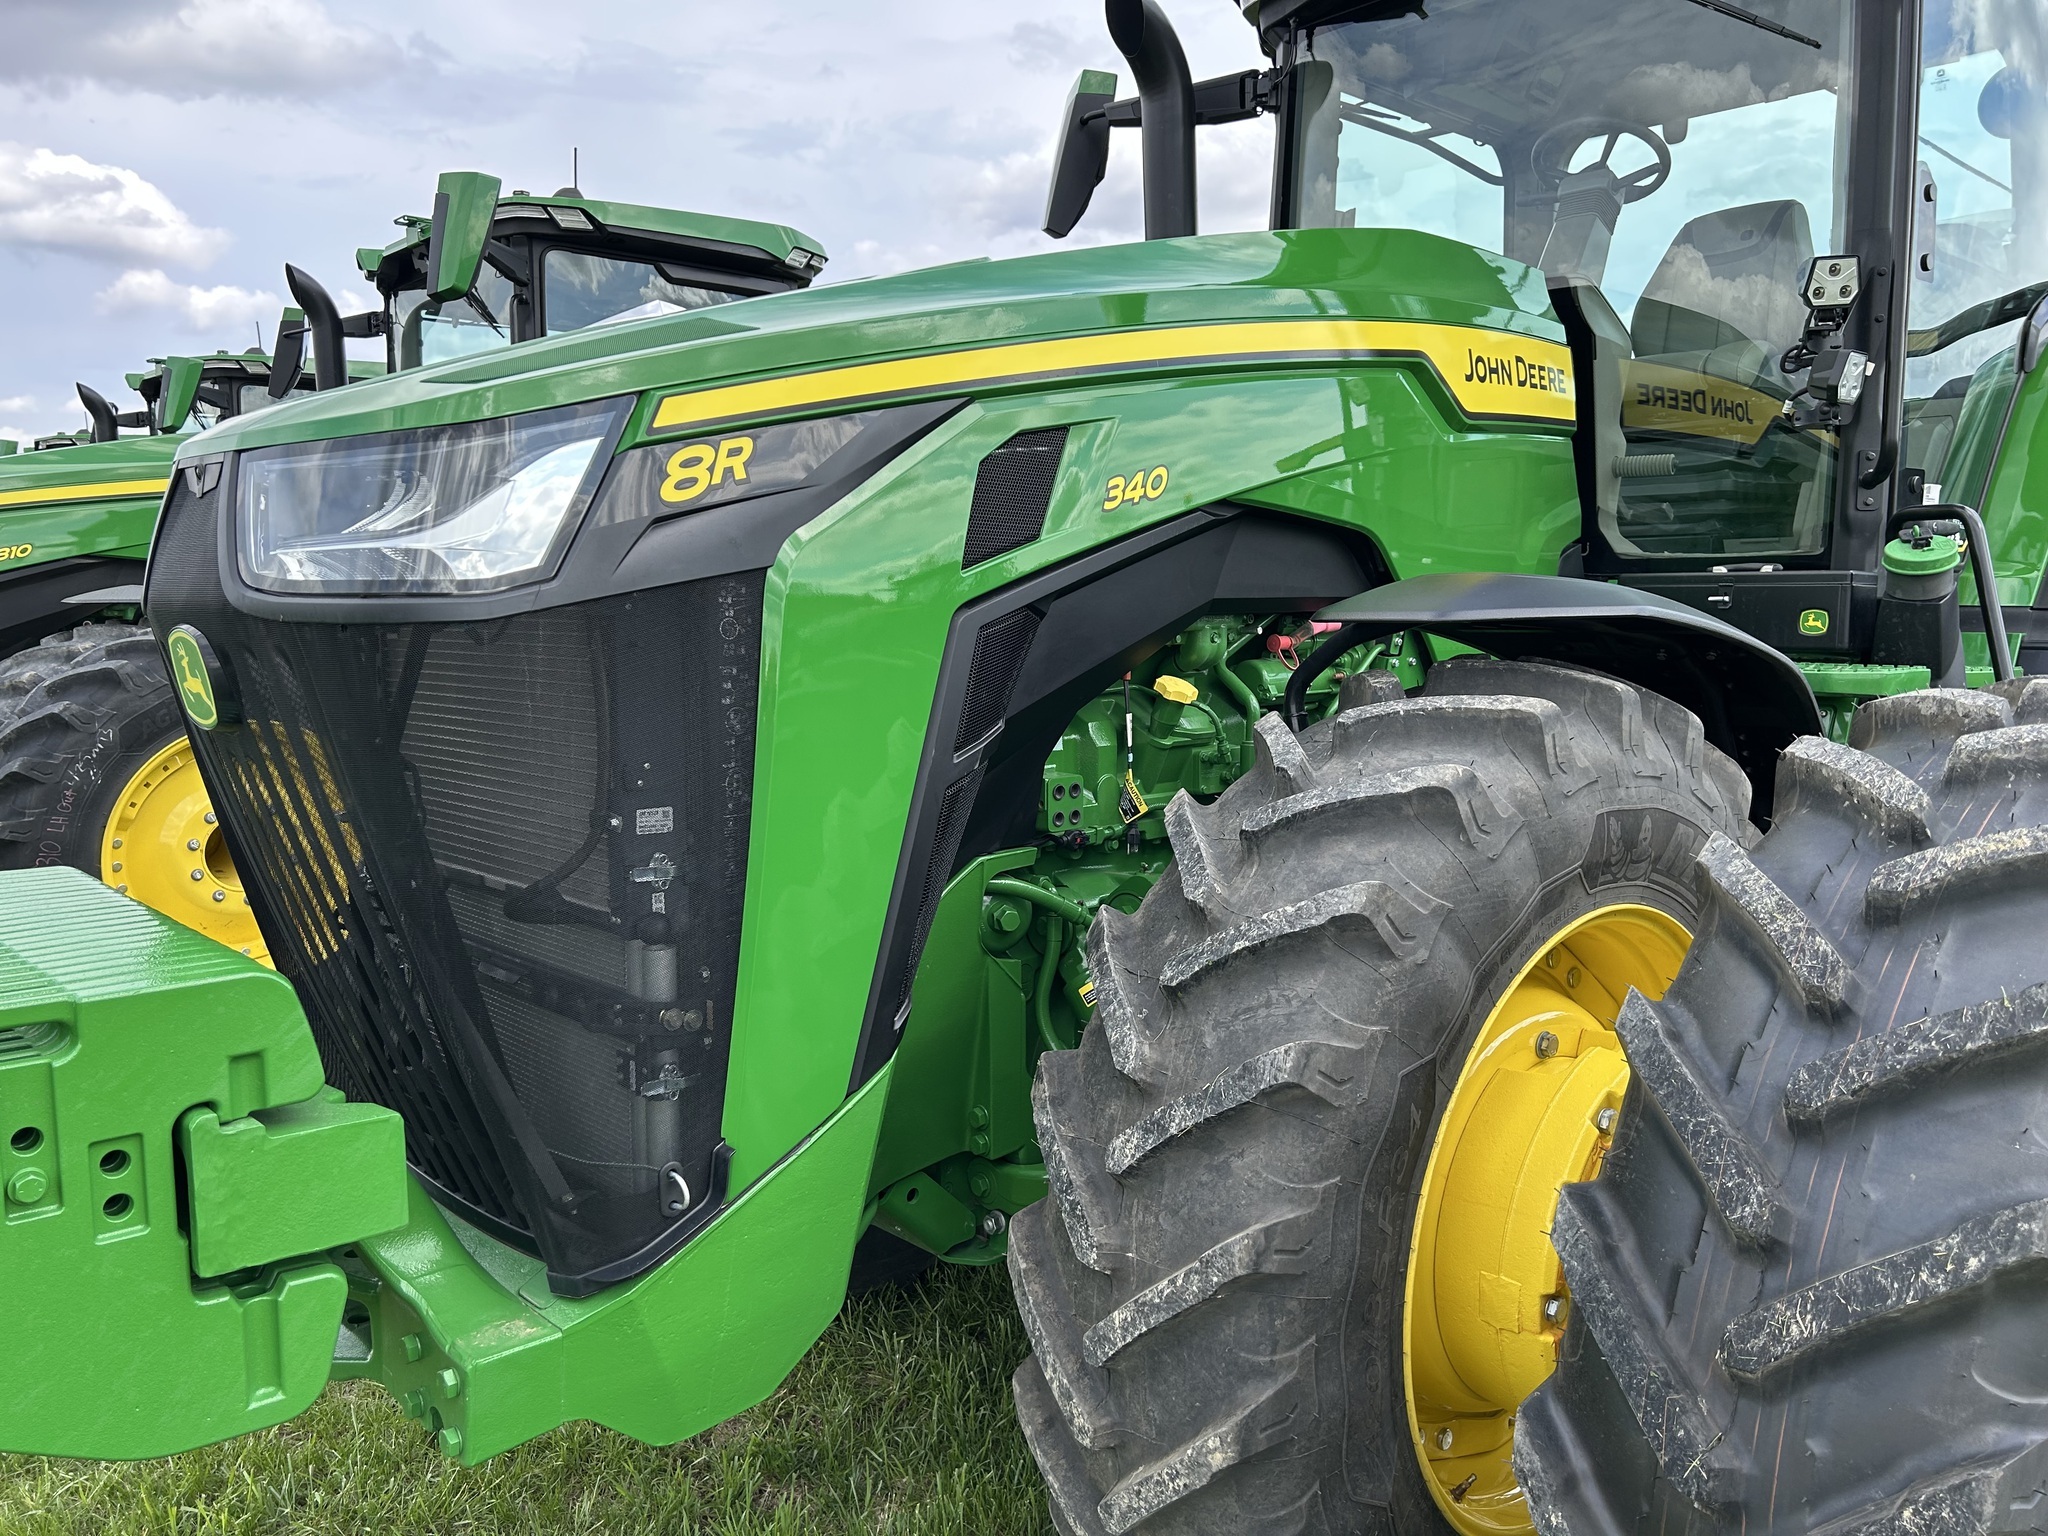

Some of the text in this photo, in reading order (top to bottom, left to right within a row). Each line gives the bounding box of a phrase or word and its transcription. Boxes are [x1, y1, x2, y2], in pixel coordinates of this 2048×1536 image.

[1464, 348, 1567, 394] JOHN DEERE
[659, 435, 756, 505] 8R
[1102, 464, 1170, 512] 340
[1126, 780, 1144, 808] CAUTION
[46, 816, 69, 833] LH
